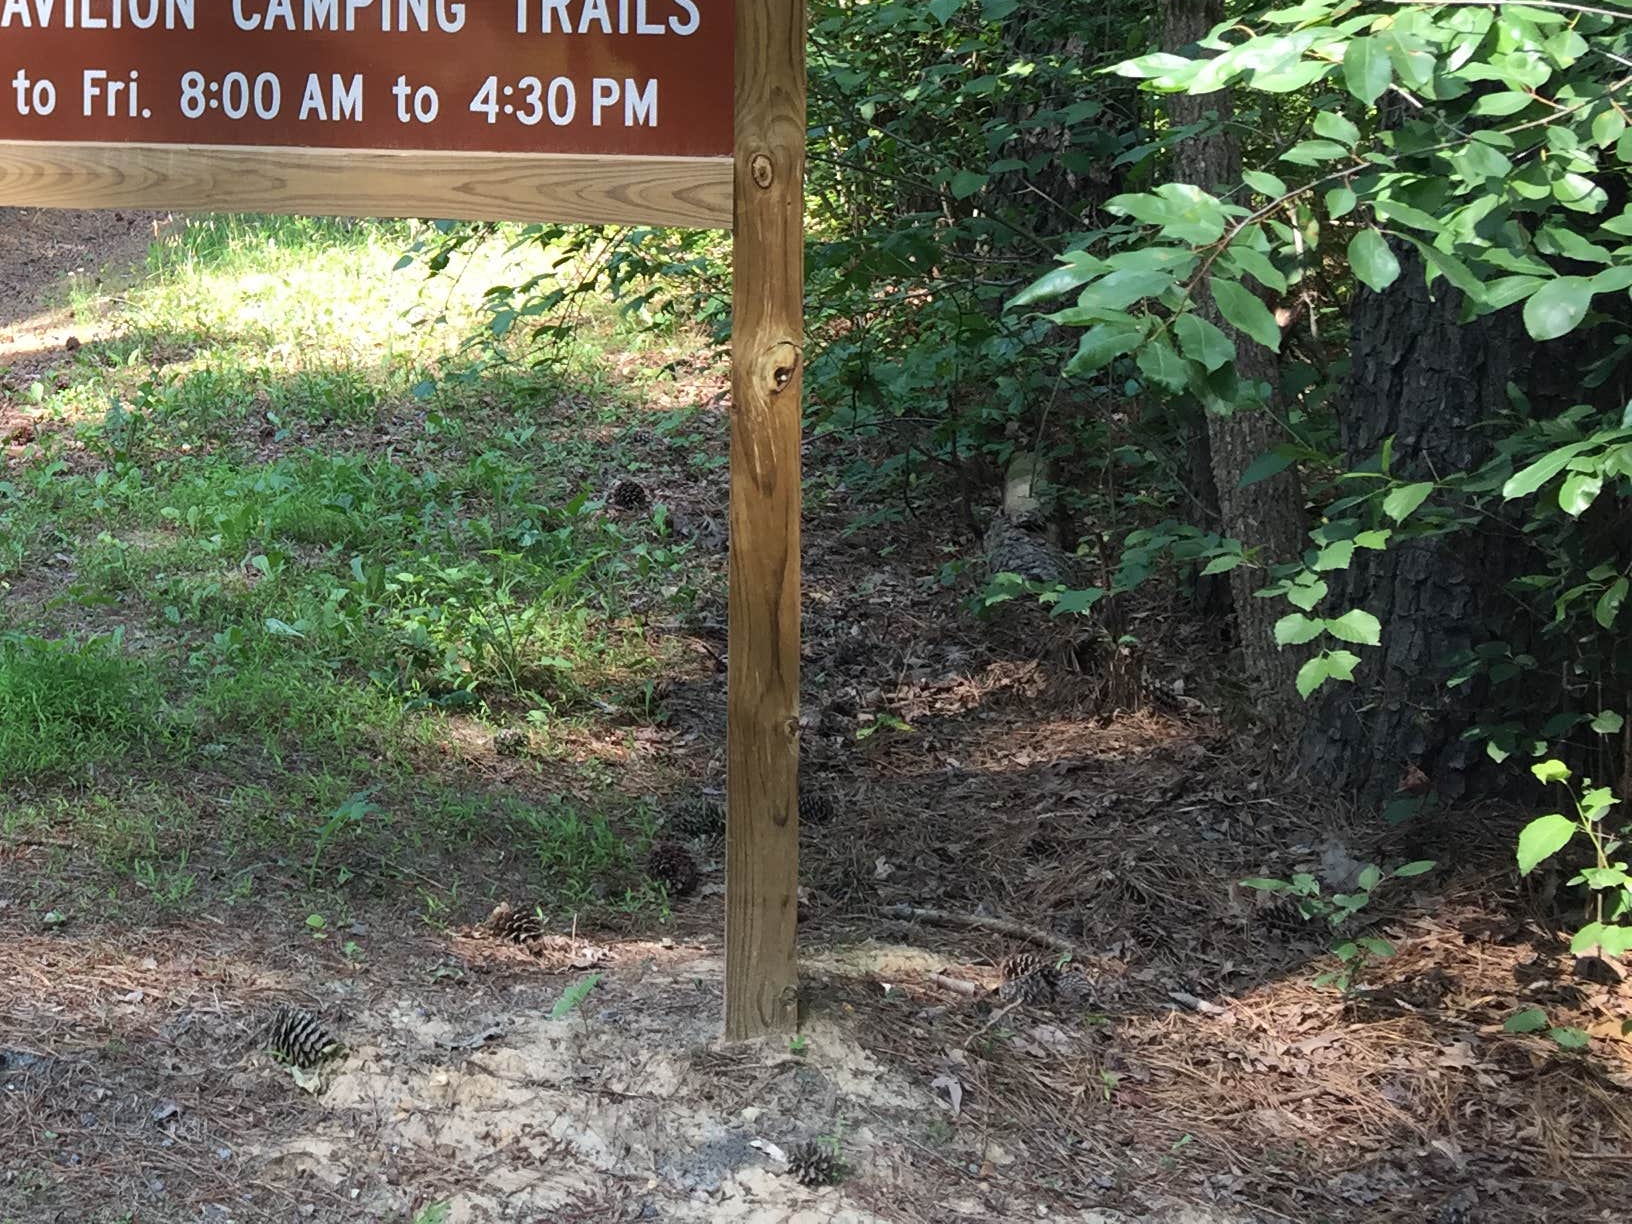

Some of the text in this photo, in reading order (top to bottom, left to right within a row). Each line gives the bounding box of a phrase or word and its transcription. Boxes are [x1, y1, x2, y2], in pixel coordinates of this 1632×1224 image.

[11, 68, 57, 116] to
[83, 69, 152, 119] Fri.
[180, 70, 281, 120] 8:00
[298, 73, 363, 122] AM
[391, 74, 439, 124] to
[469, 75, 577, 126] 4:30
[592, 77, 658, 127] PM
